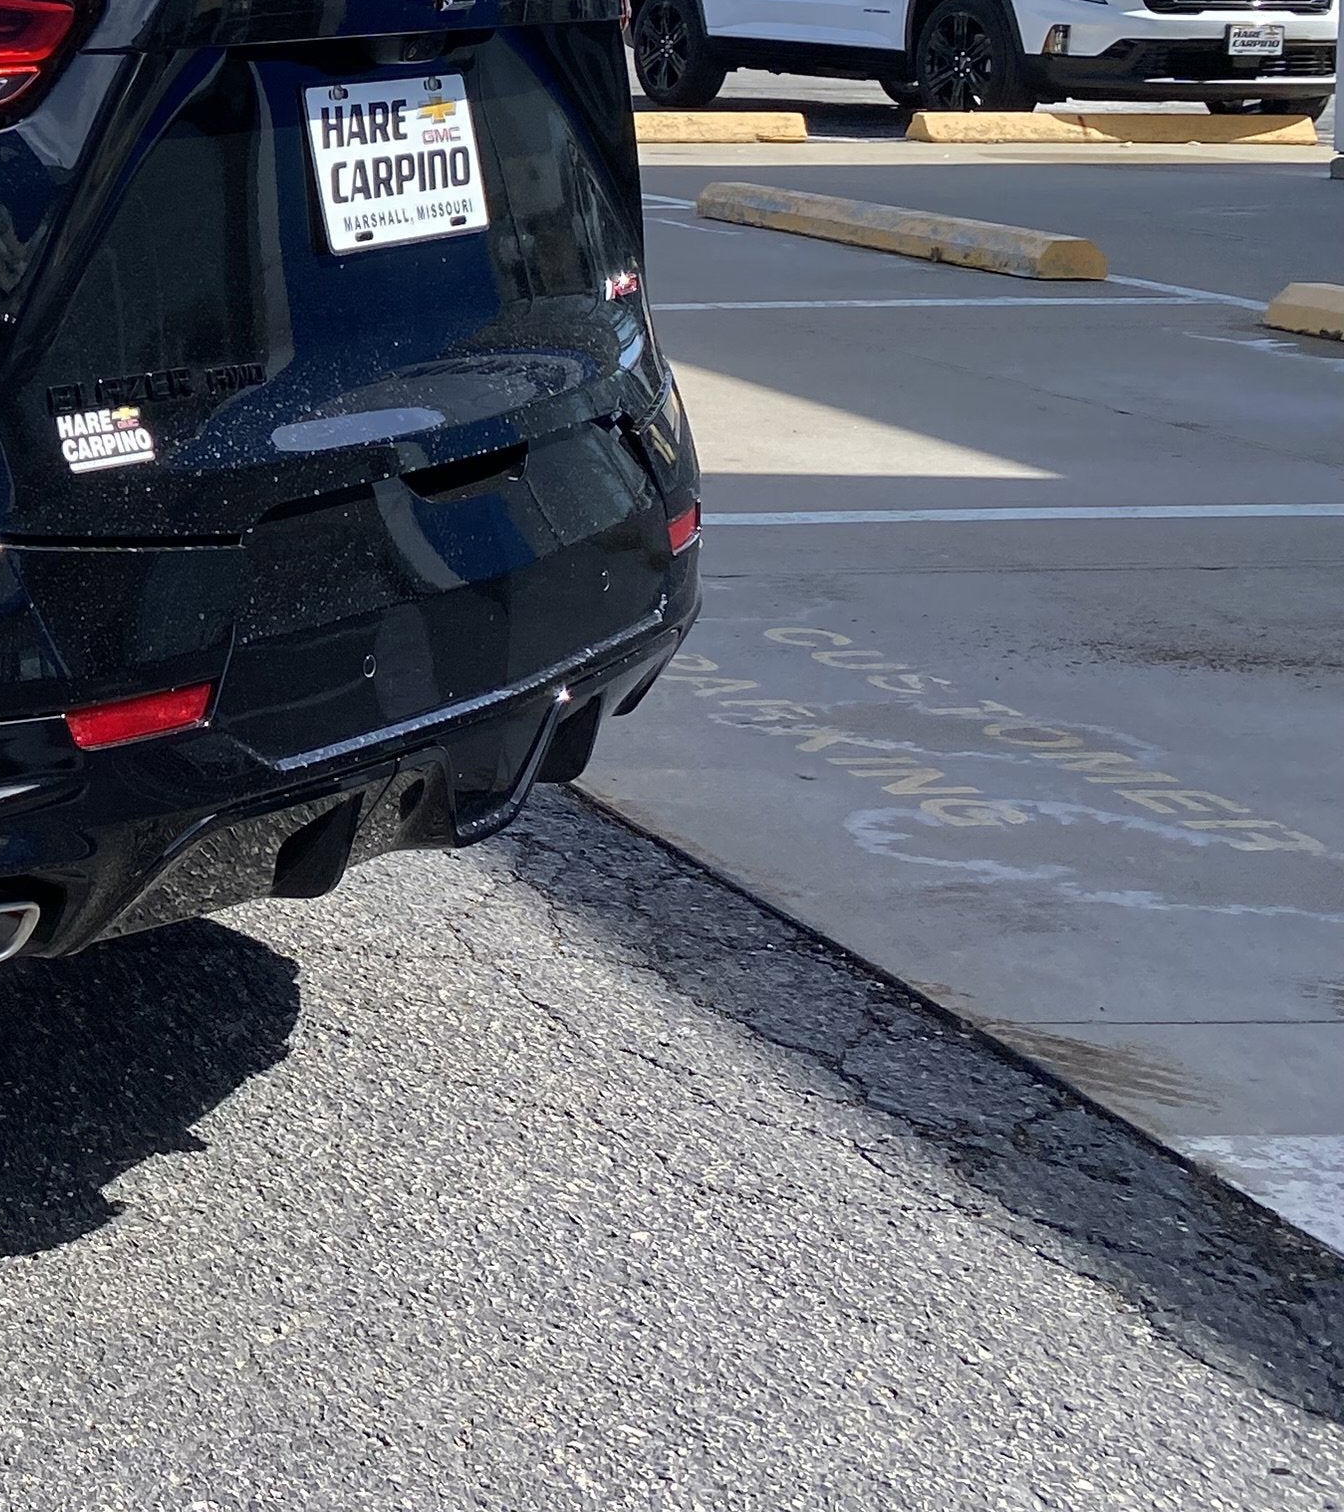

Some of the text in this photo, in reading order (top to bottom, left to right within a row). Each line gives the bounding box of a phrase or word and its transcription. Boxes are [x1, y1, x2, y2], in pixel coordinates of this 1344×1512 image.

[320, 99, 408, 149] HARE
[422, 126, 462, 145] GMC
[331, 146, 470, 203] CARPINO
[343, 198, 474, 232] MARSHALL, MISSOURI
[56, 408, 114, 439] HARE
[62, 427, 153, 462] CARPINO
